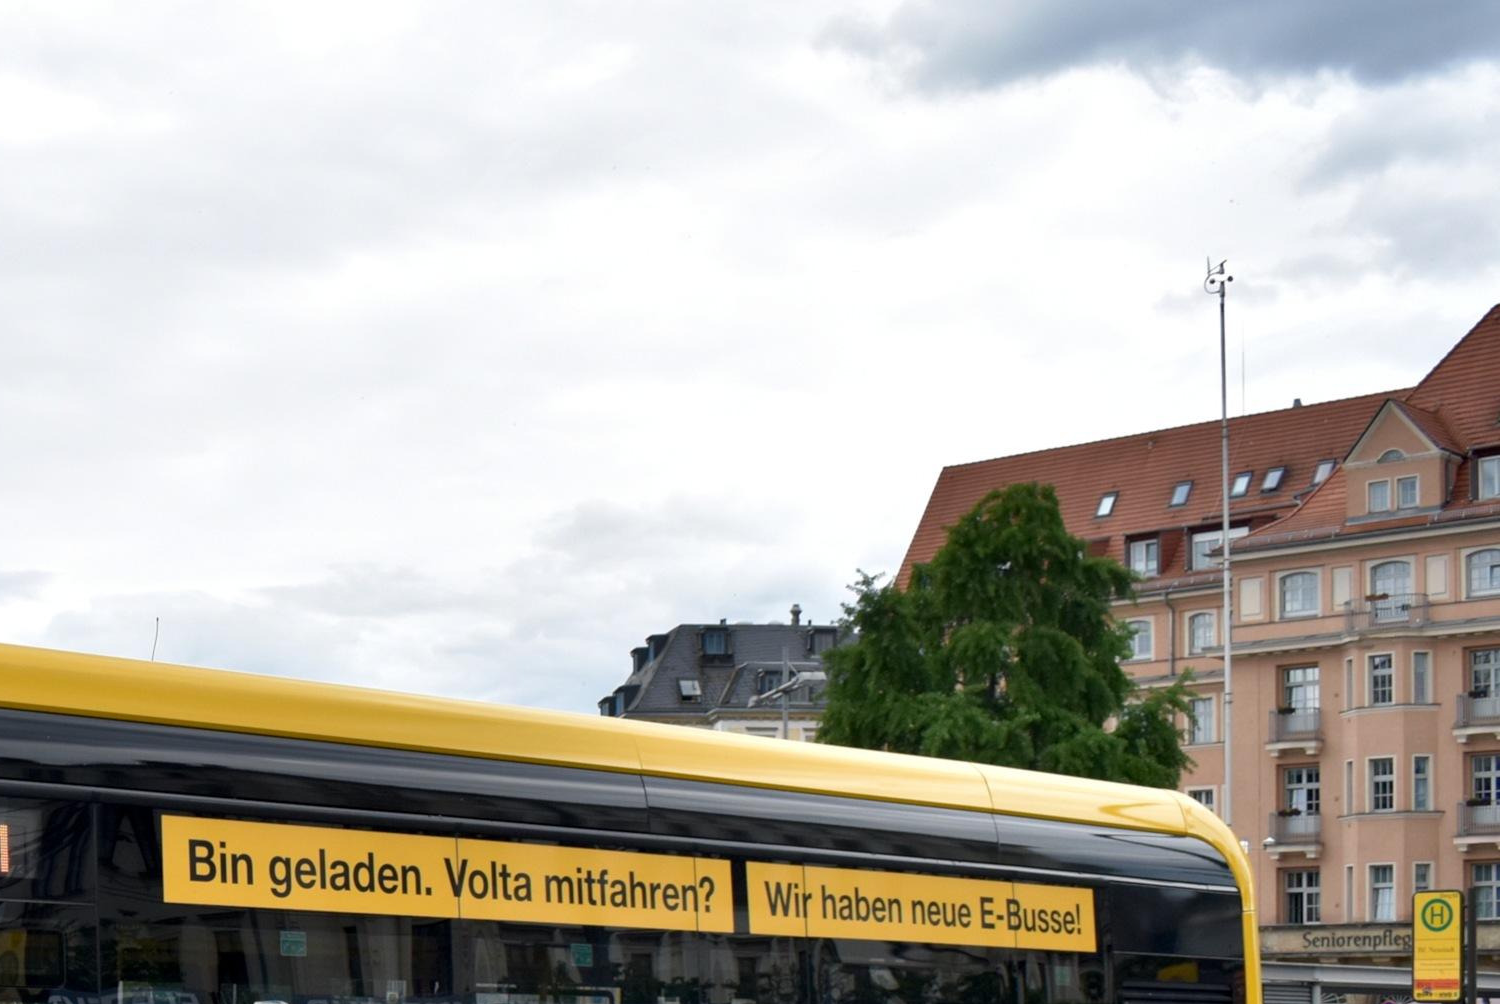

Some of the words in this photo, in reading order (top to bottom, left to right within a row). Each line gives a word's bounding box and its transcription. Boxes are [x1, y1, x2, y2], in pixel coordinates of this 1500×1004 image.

[188, 839, 253, 885] Bin
[269, 848, 432, 898] geladen.
[444, 858, 532, 902] Volta
[545, 867, 715, 913] mitfahren?
[764, 881, 812, 918] Wir
[821, 885, 902, 923] haben
[911, 899, 971, 928] neue
[980, 896, 1082, 935] E-Busse!
[1431, 906, 1444, 924] H
